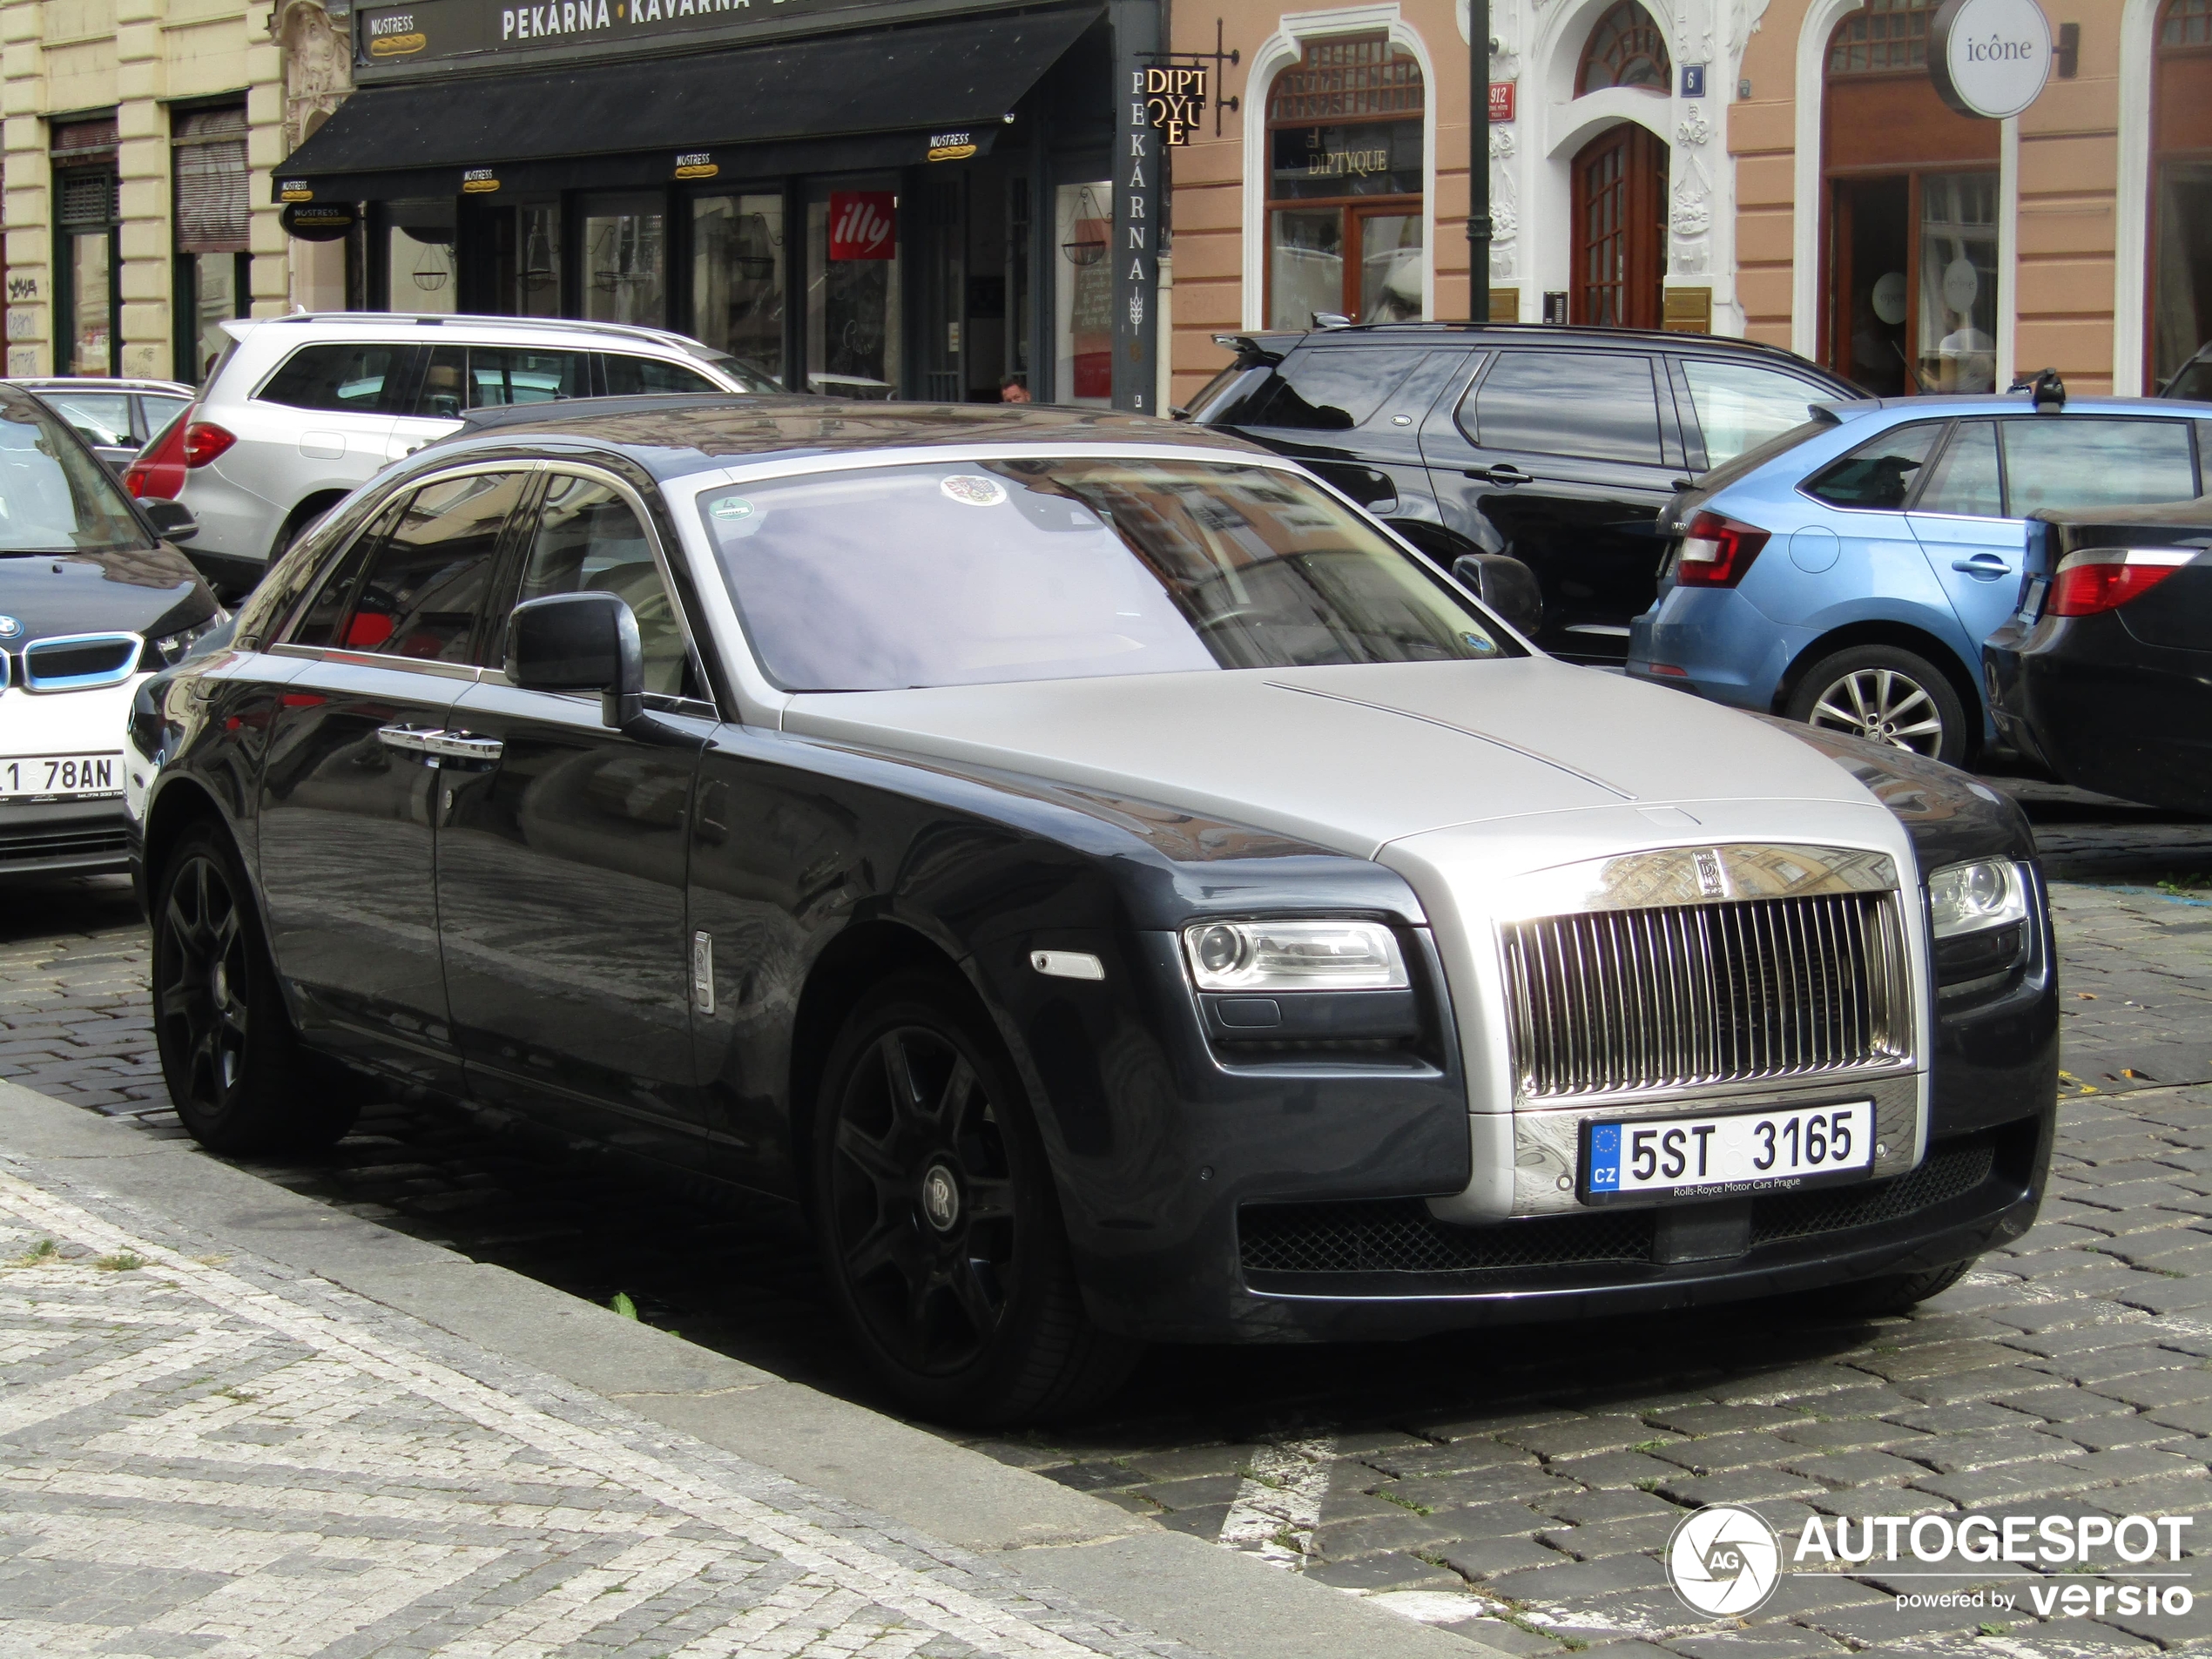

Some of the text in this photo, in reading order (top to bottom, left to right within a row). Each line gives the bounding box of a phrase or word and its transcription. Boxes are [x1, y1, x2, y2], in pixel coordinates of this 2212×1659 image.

[371, 15, 414, 36] NOSTRESS
[502, 0, 610, 41] PEKÁRNA
[1967, 33, 2032, 62] icône
[1687, 71, 1695, 89] 6
[1490, 87, 1507, 104] 912
[930, 134, 969, 147] NOSTRESS
[677, 153, 711, 165] NOSTRESS
[1309, 150, 1387, 178] DIPTYQUE
[464, 169, 493, 181] NOSTRESS
[1129, 71, 1146, 280] PEKÁRNA
[282, 181, 307, 191] NOSTRESS
[294, 208, 339, 217] NOSTRESS
[834, 202, 890, 253] illy
[44, 759, 111, 790] 78AN
[1632, 1110, 1852, 1180] 5ST 3165
[1595, 1168, 1616, 1184] CZ
[1674, 1177, 1801, 1197] Rolls-Royce Motor Cars Prague
